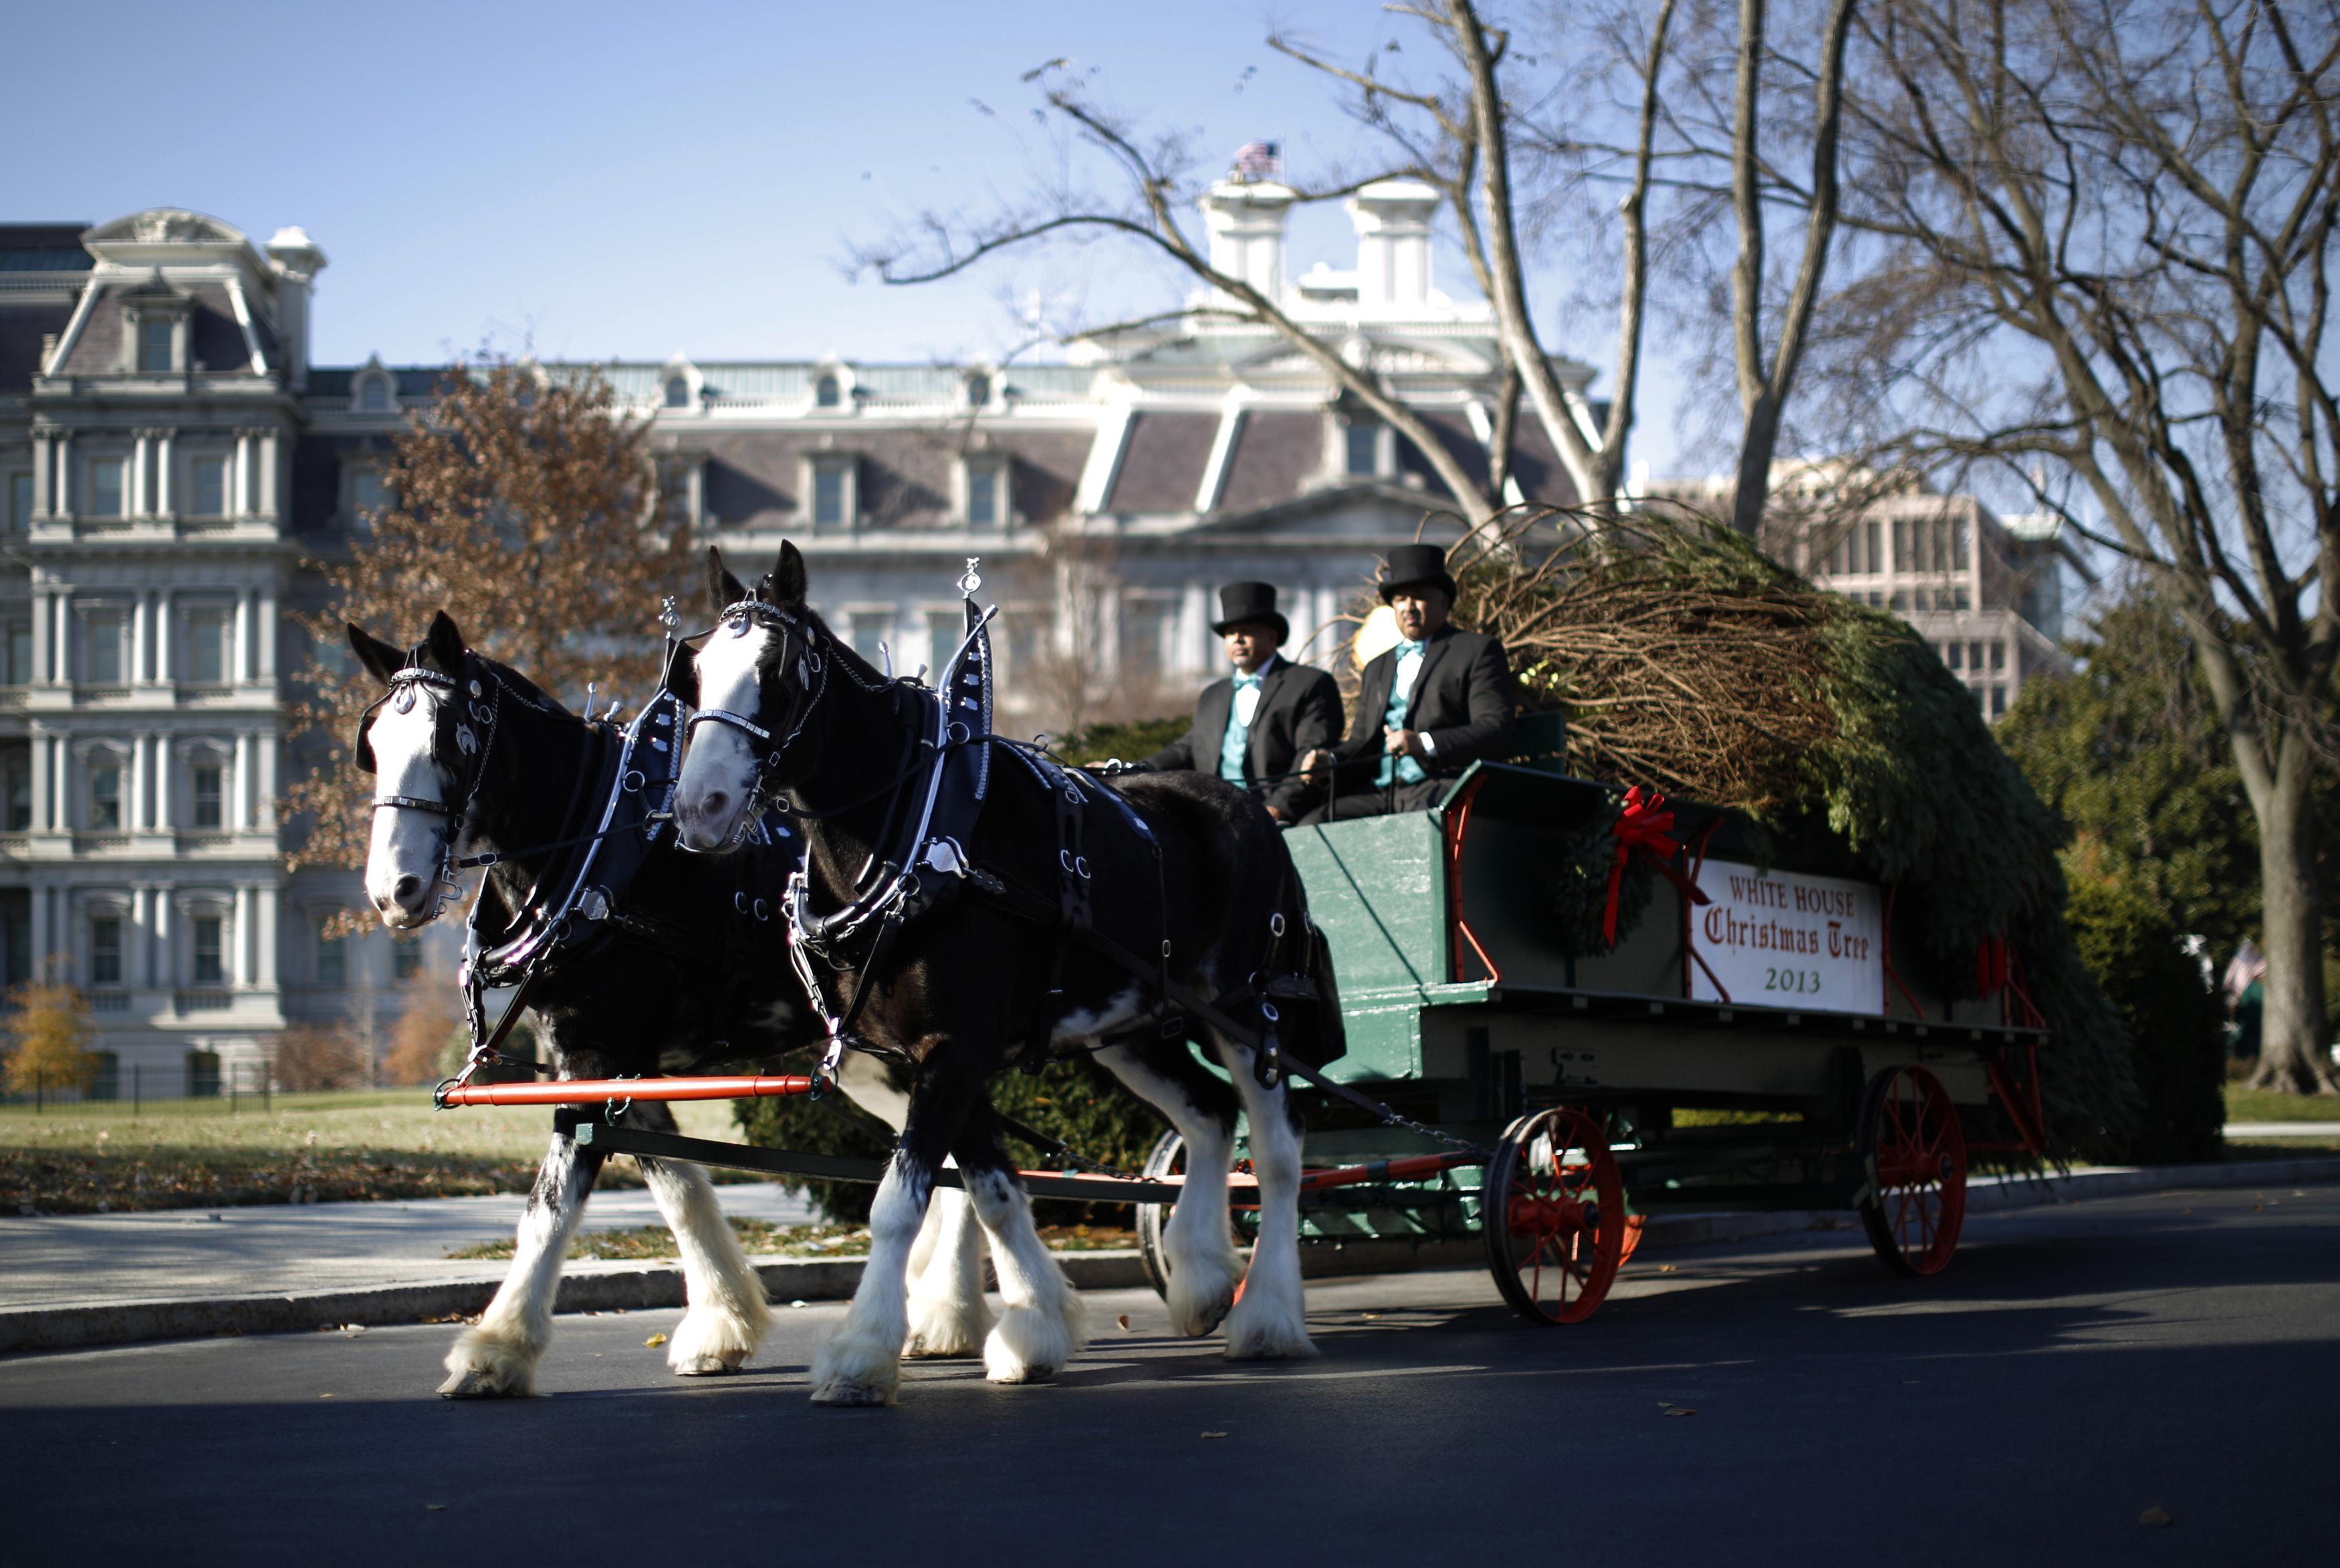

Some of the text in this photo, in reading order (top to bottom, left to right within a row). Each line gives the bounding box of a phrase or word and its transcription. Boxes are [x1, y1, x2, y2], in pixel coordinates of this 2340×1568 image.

[1730, 875, 1855, 918] WHITE HOUSE
[1704, 906, 1869, 960] Christmas Tree
[1765, 968, 1821, 994] 2013
